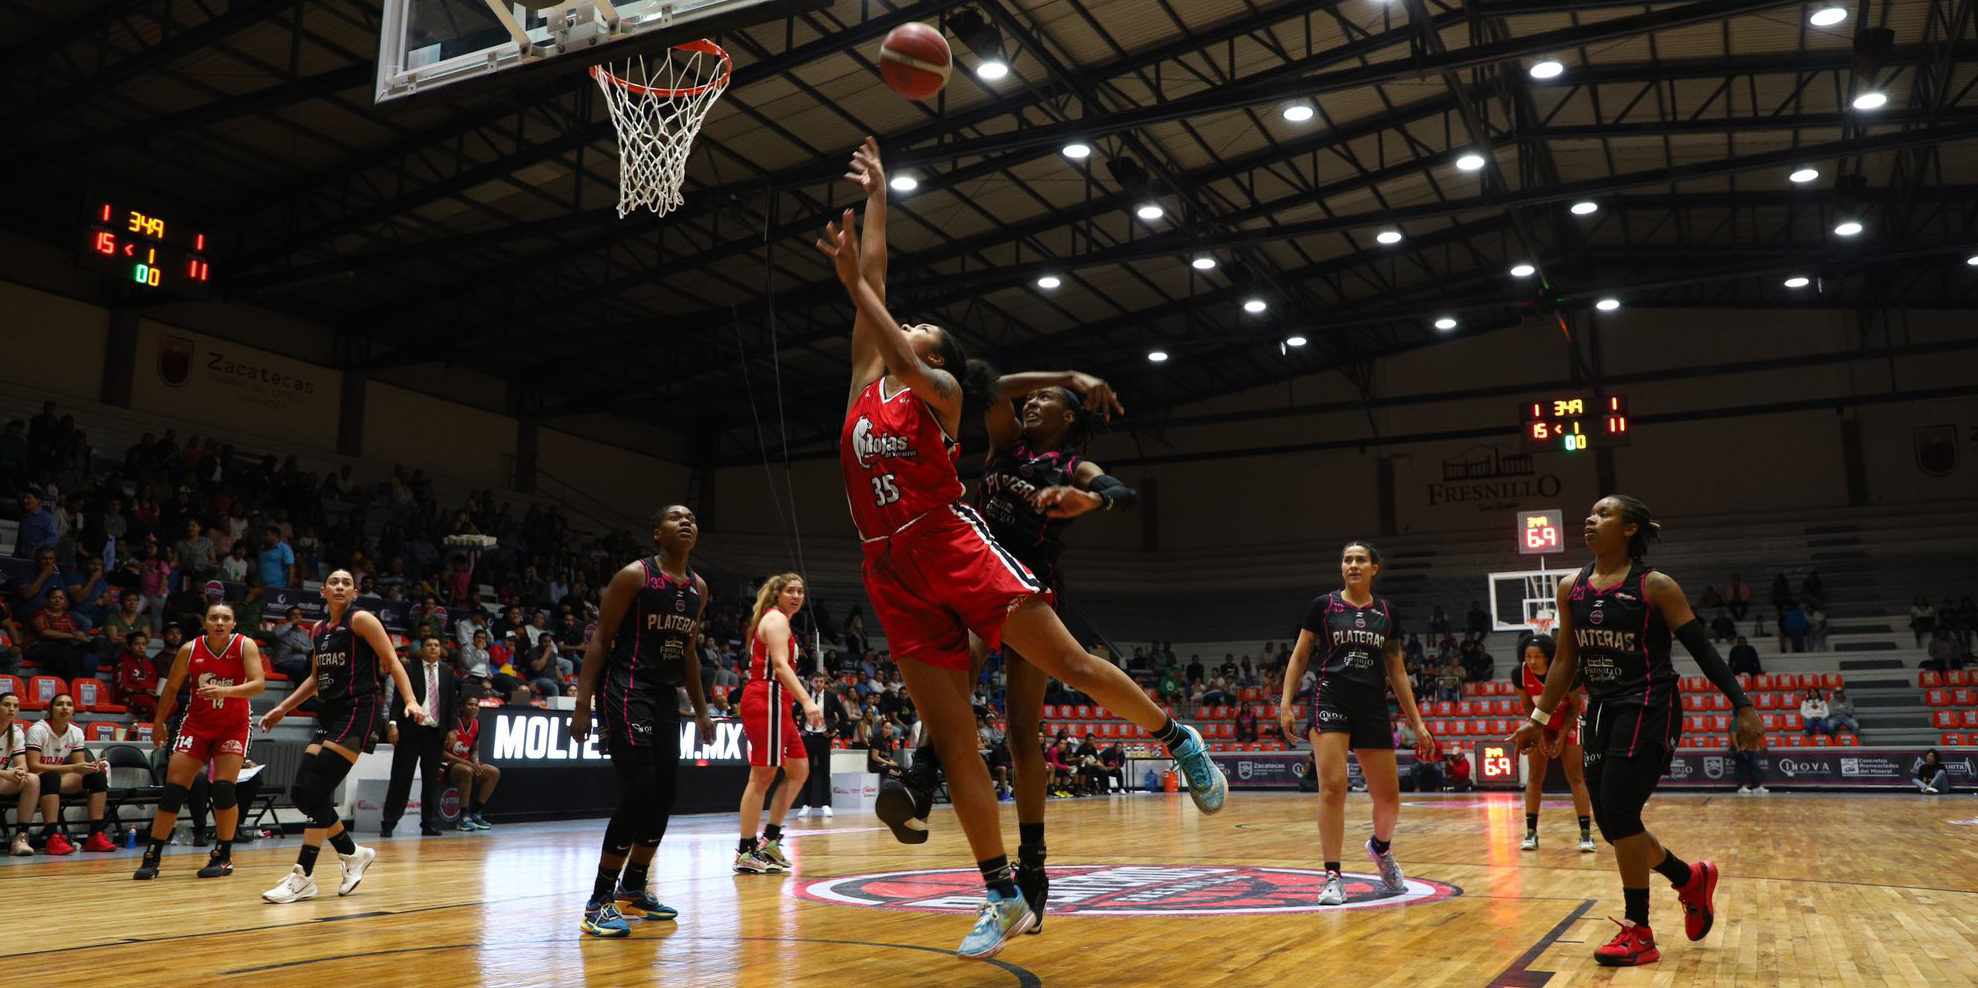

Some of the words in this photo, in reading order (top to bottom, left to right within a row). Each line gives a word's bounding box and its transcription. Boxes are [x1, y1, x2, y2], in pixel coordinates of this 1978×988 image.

[102, 204, 111, 221] 1
[196, 234, 204, 250] 1
[96, 232, 115, 254] 15
[148, 248, 155, 264] 1
[190, 260, 207, 281] 11
[206, 352, 315, 394] Zacatecas
[1533, 423, 1548, 438] 15
[1610, 417, 1626, 432] 11
[866, 432, 908, 455] Rojas
[872, 474, 899, 506] 35
[1427, 474, 1561, 506] FRESNILLO
[1527, 528, 1556, 548] 6.9
[651, 577, 666, 589] 33
[1333, 630, 1385, 649] PLATERAS
[178, 736, 193, 749] 14
[40, 756, 70, 766] ROJA
[1485, 758, 1510, 775] 6.9
